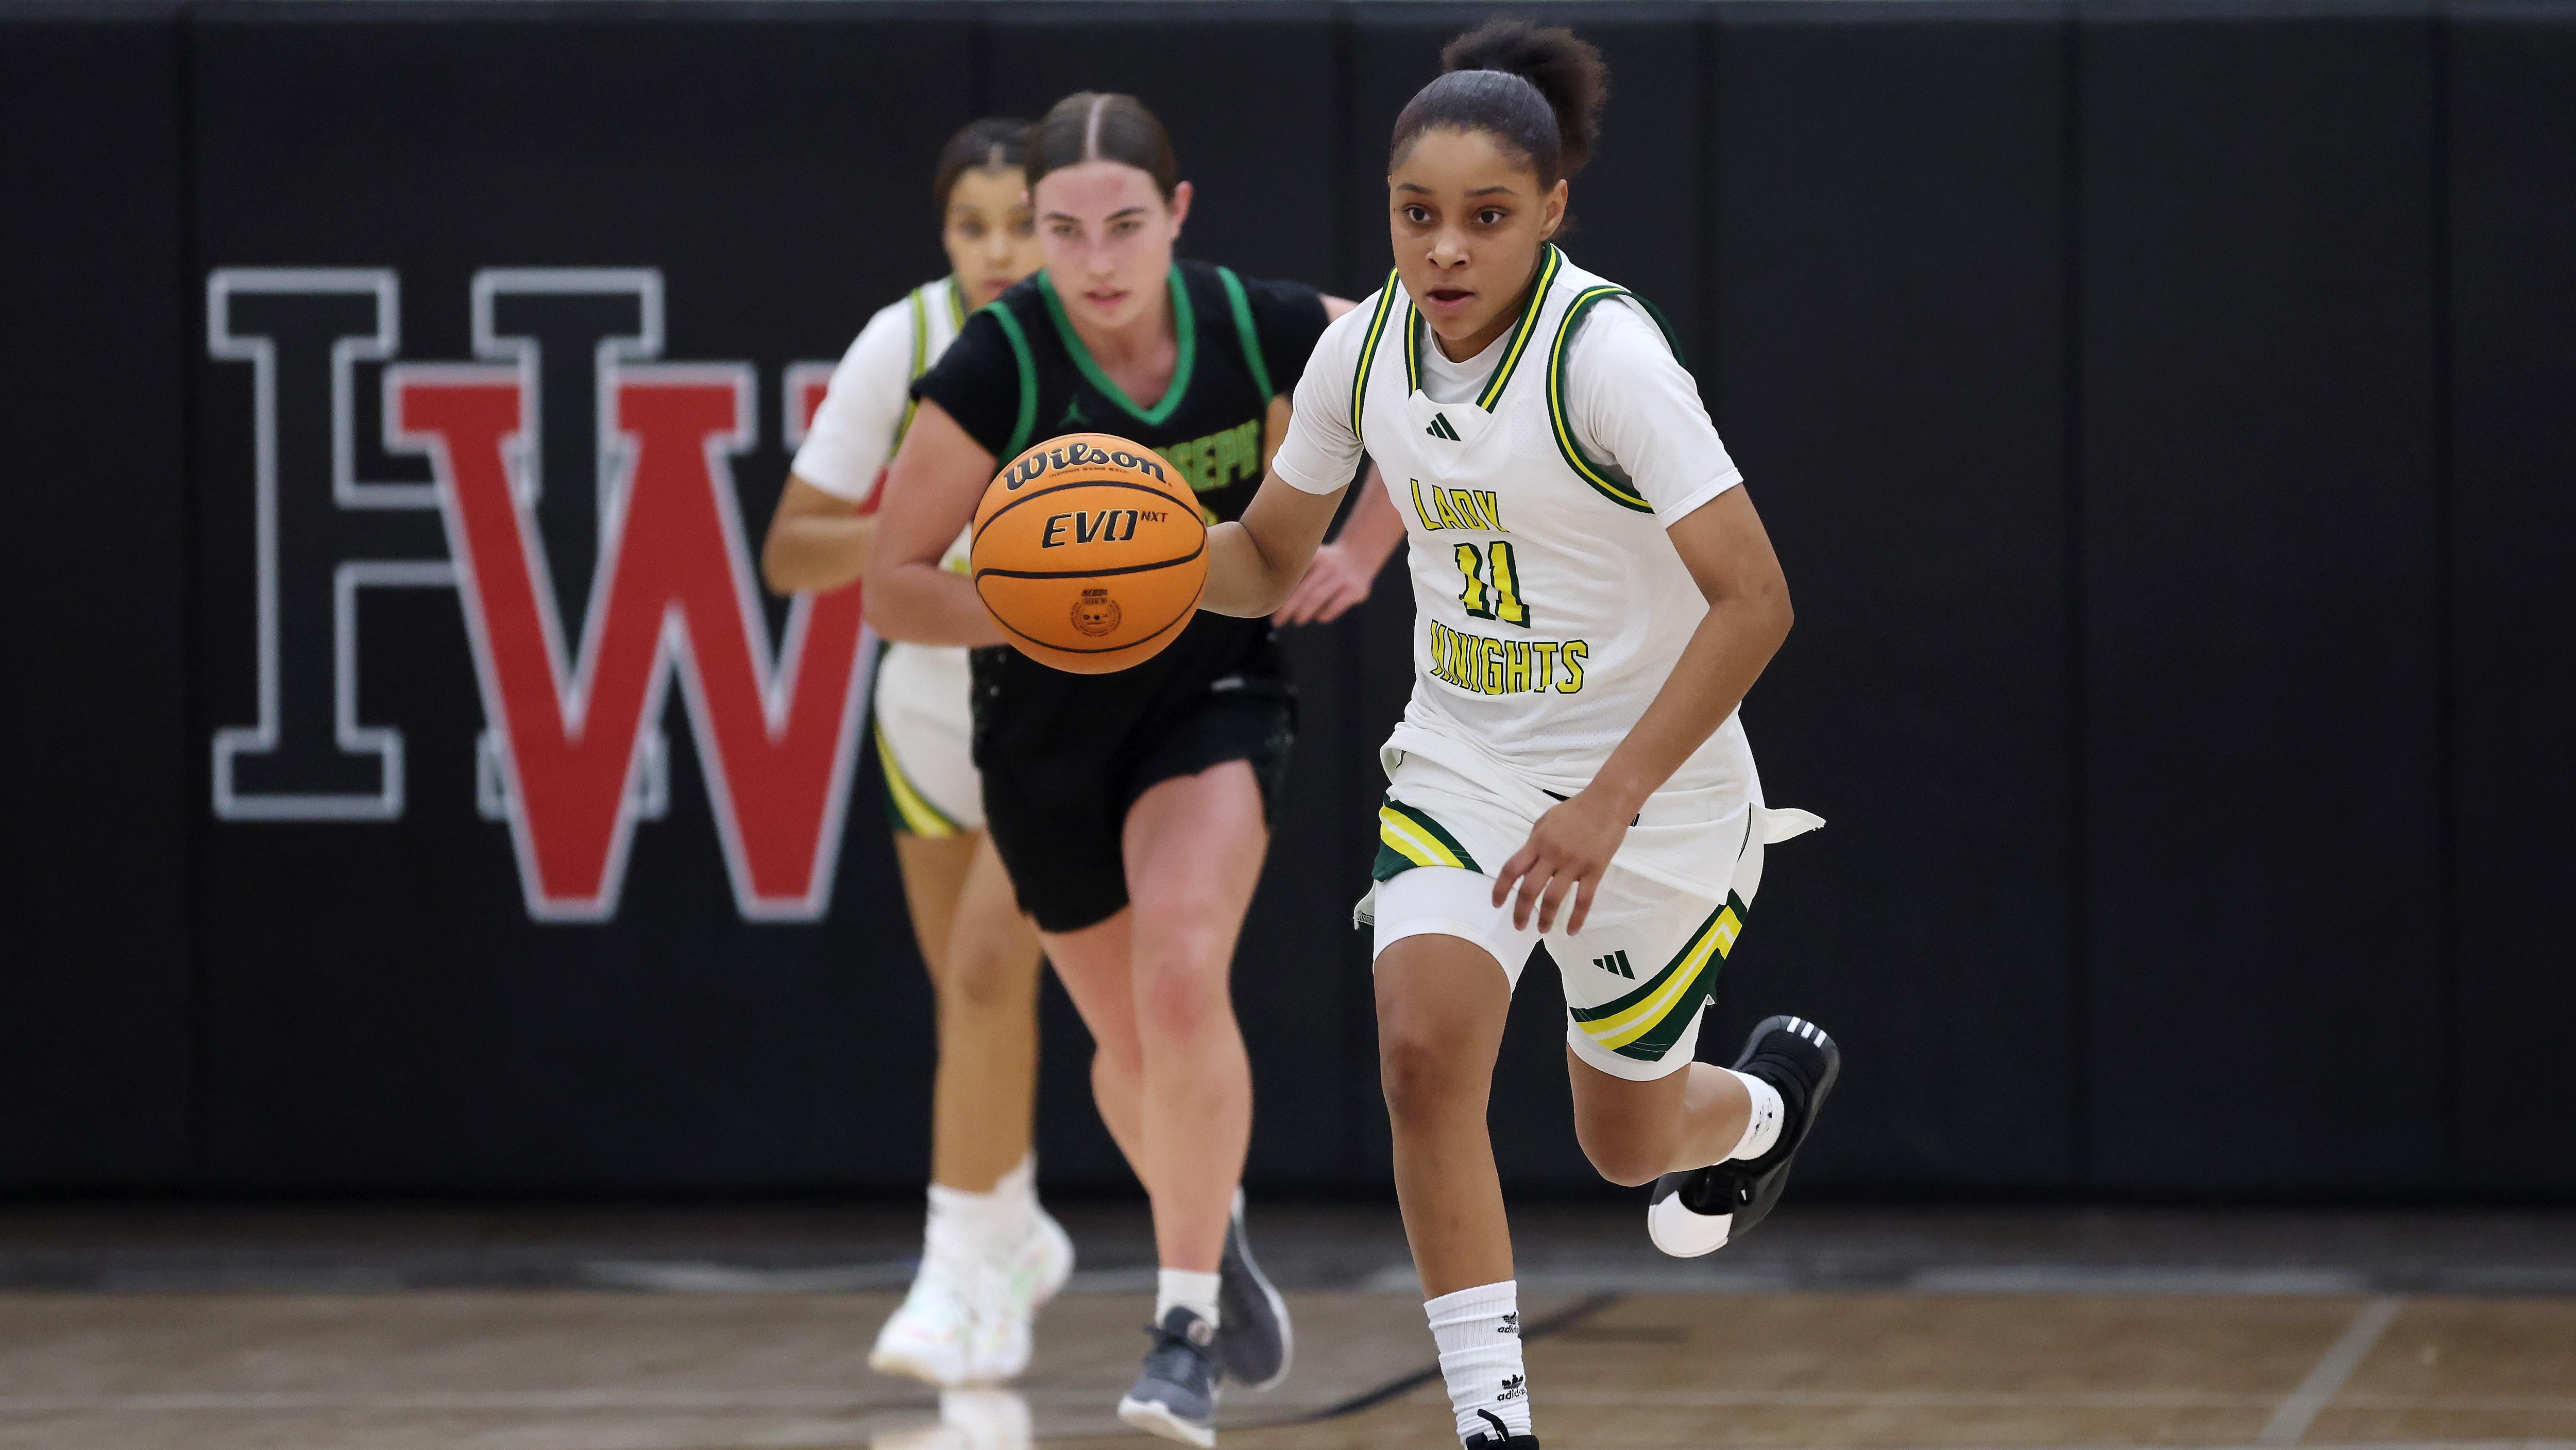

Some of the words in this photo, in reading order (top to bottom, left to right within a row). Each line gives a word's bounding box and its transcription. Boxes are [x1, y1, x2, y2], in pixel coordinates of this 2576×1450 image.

[1004, 442, 1166, 491] Wilson
[1152, 418, 1259, 492] SEPH
[1041, 509, 1139, 549] EVO
[1140, 511, 1167, 523] NXT
[1410, 478, 1510, 532] LADY
[1453, 540, 1531, 628] 11
[1430, 619, 1589, 695] KNIGHTS
